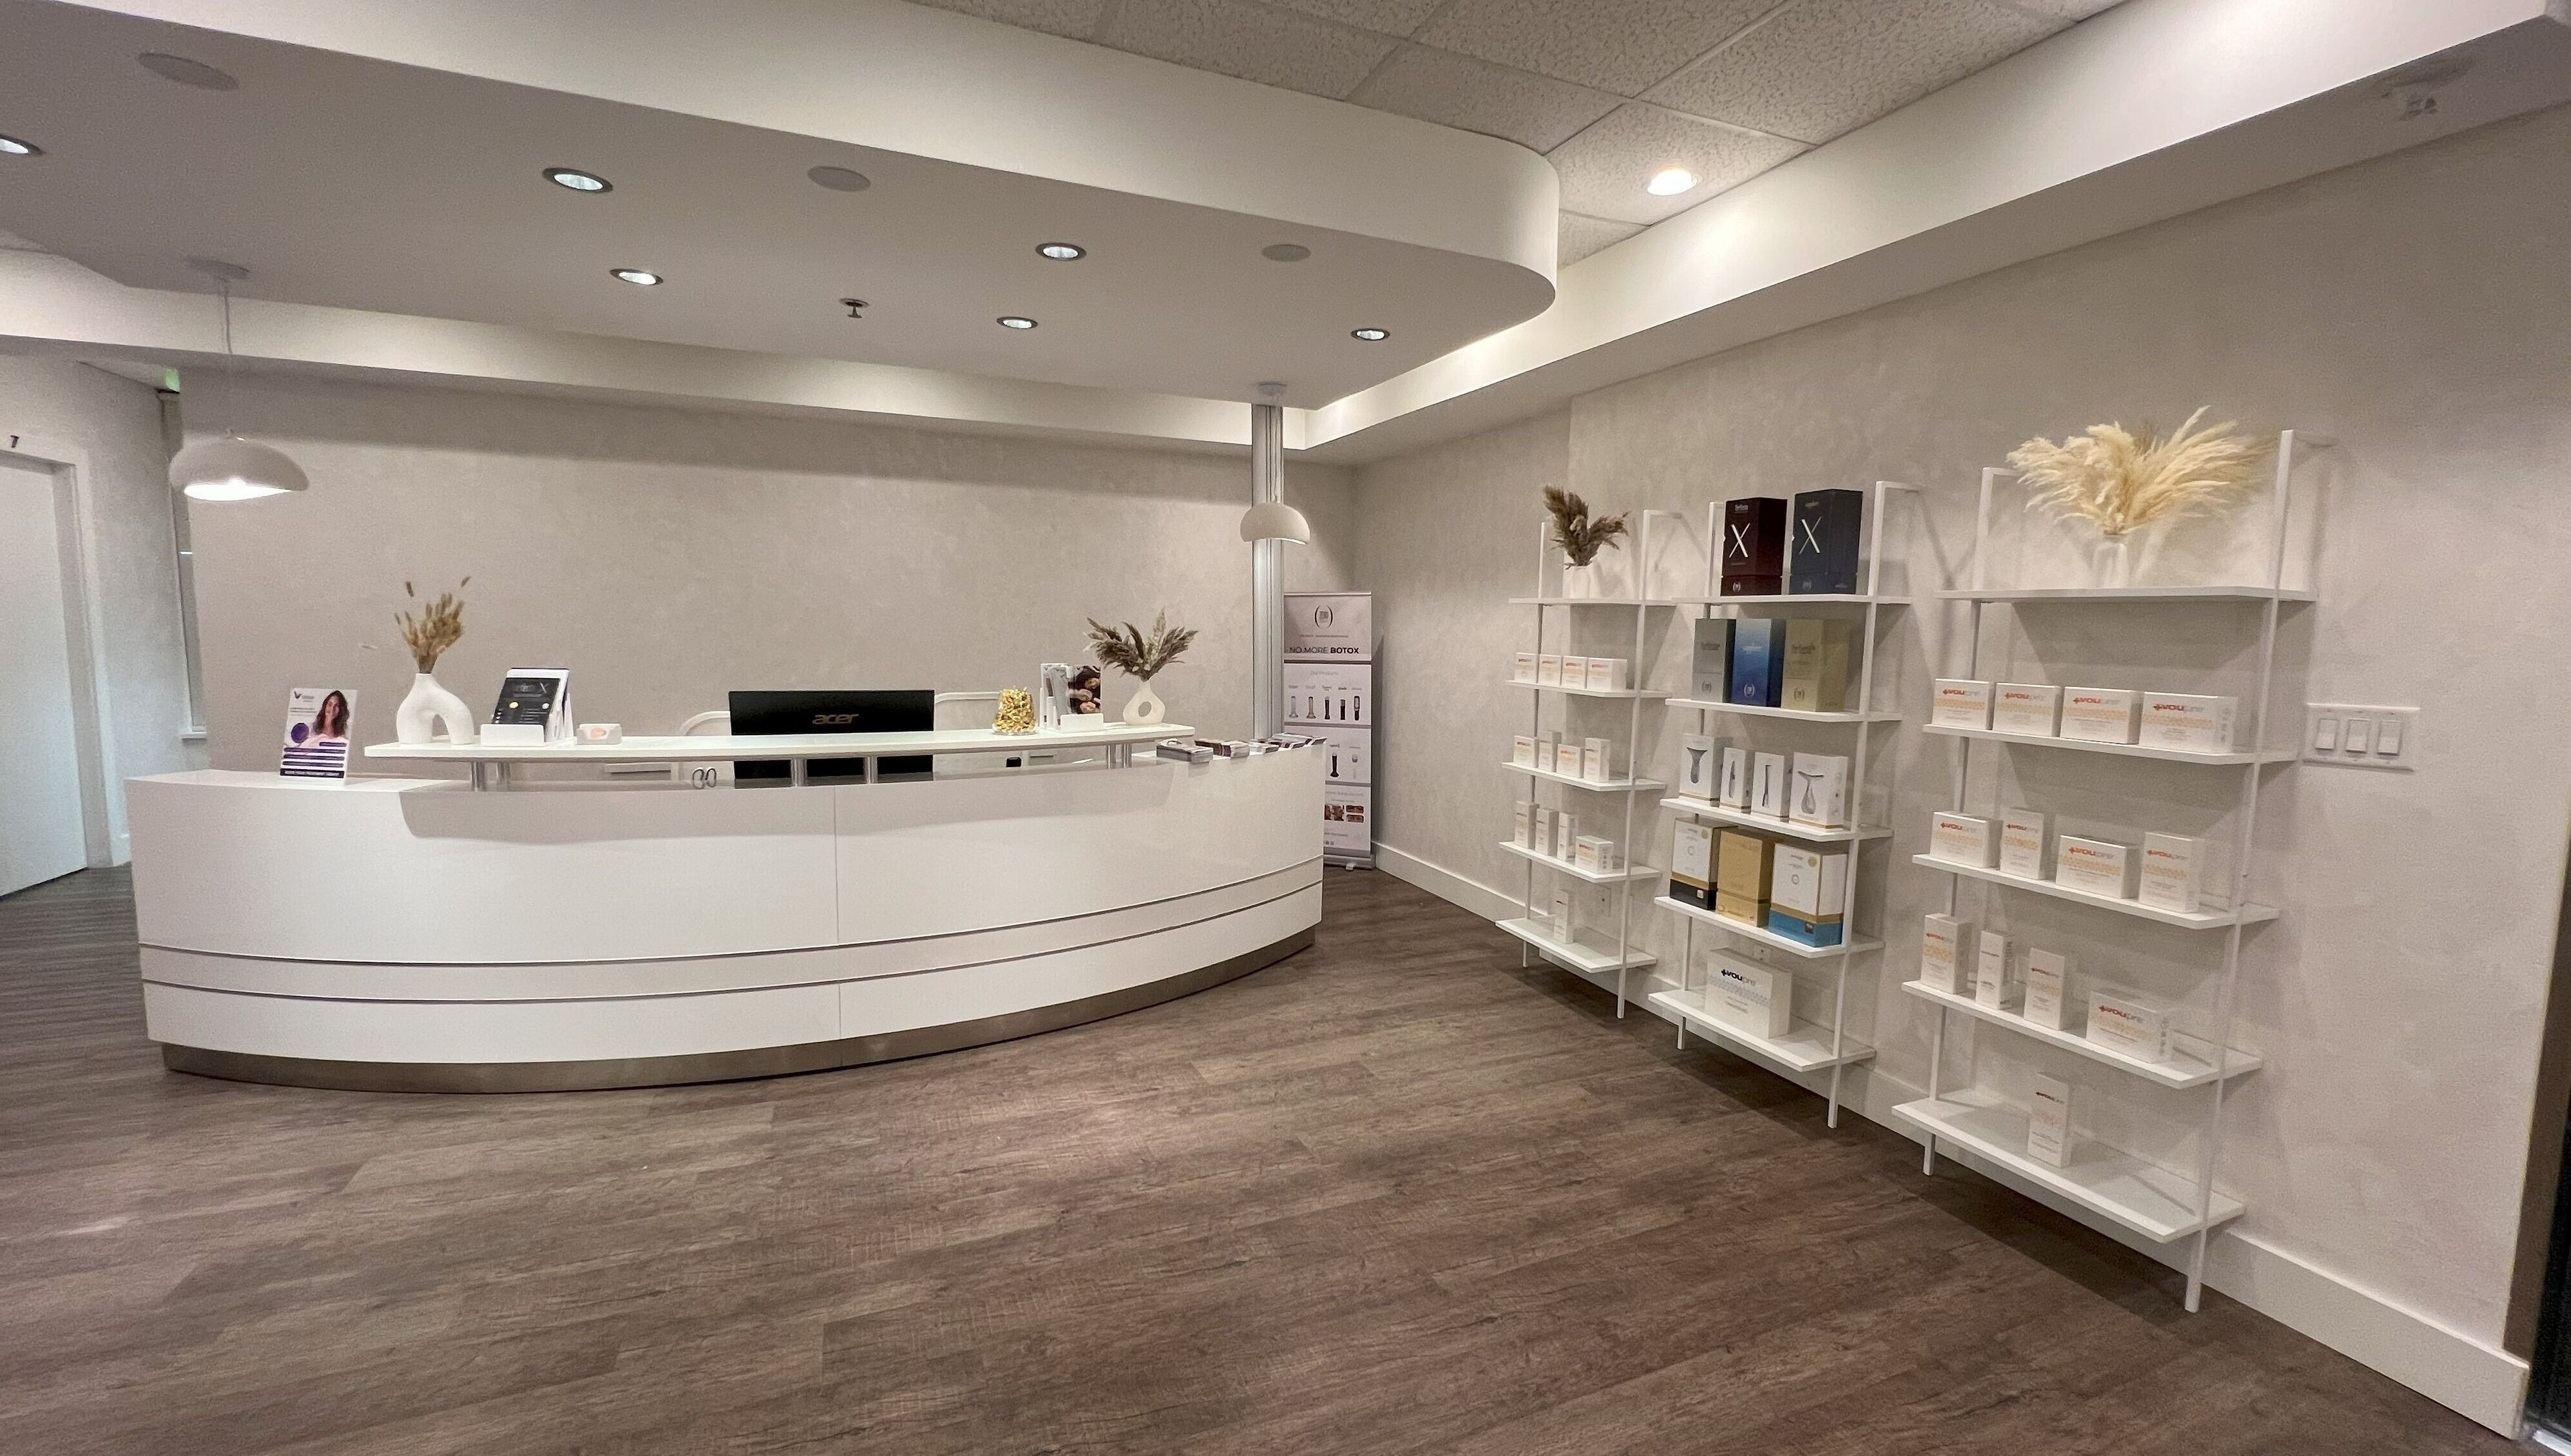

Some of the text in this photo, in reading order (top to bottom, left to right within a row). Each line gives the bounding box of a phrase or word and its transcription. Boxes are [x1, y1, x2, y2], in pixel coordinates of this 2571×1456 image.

[1729, 523, 1751, 558] X
[1799, 516, 1822, 555] X
[812, 714, 860, 724] acer
